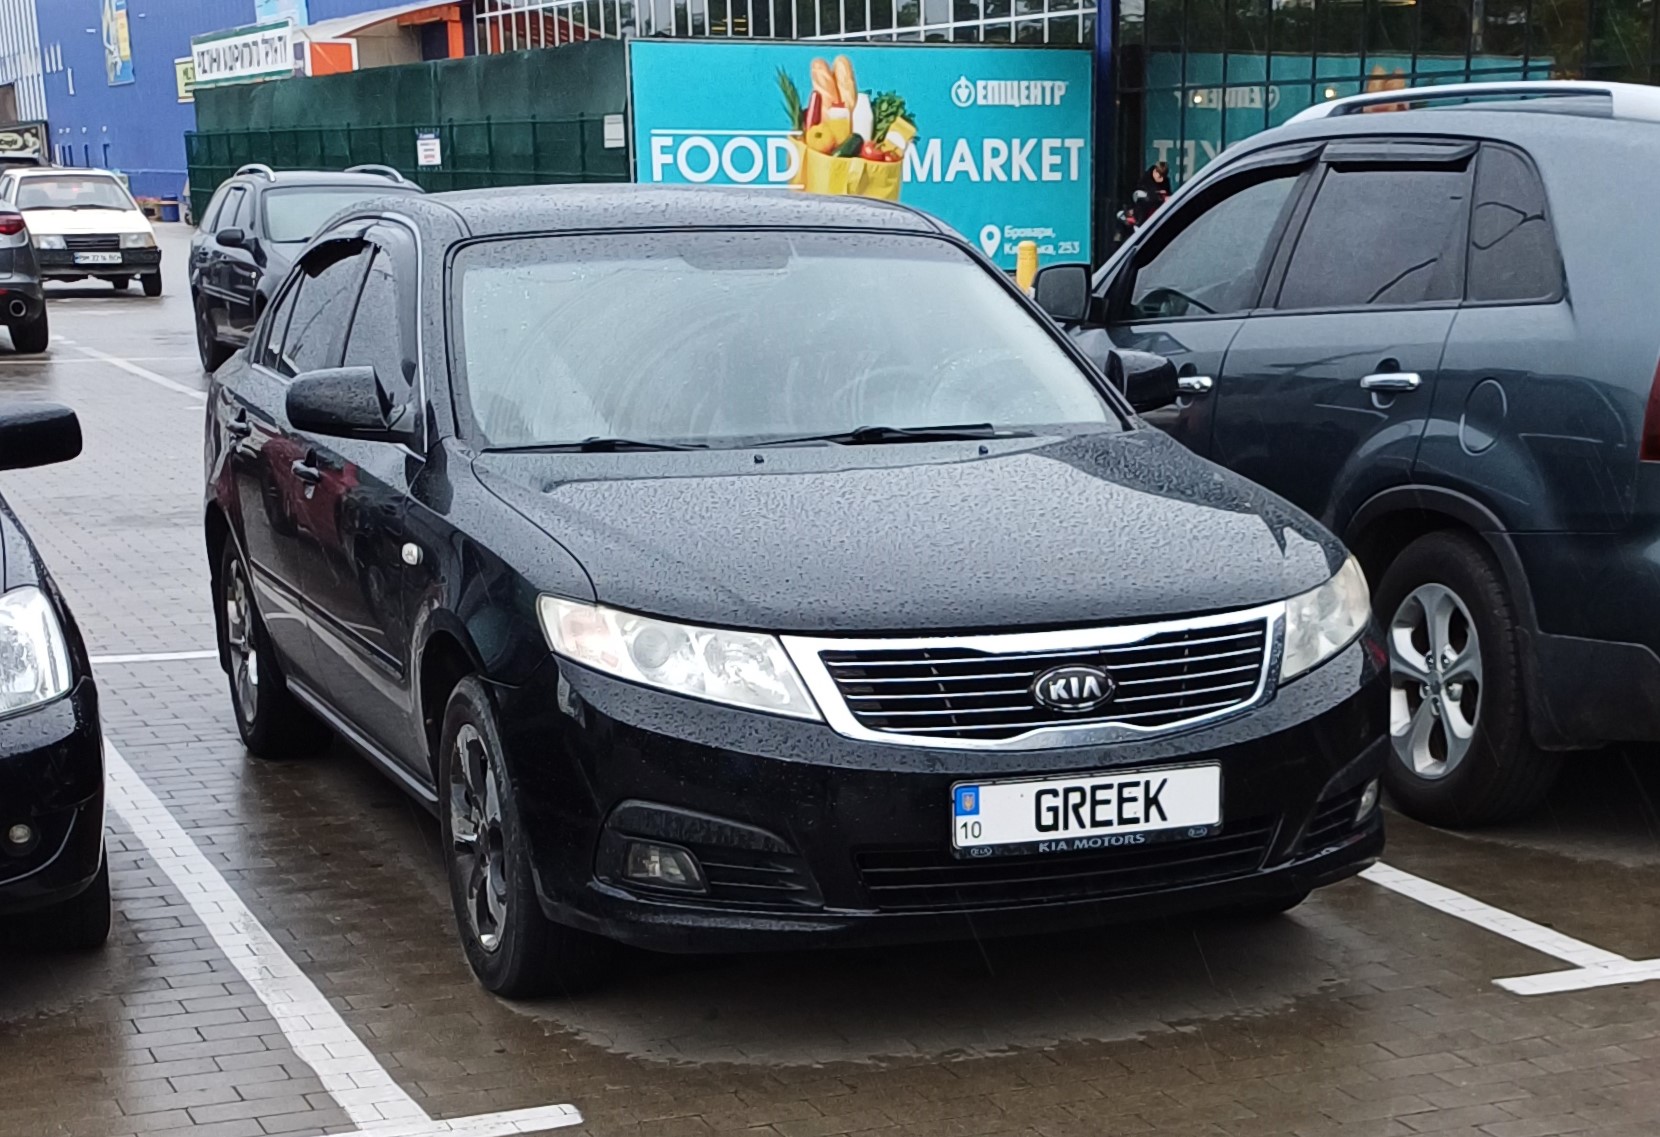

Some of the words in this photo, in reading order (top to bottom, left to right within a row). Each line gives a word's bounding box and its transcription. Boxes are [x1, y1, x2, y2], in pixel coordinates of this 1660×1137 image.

[976, 80, 1067, 107] ЕПІЦЕНТР
[651, 136, 800, 183] FOOD
[902, 138, 1085, 183] MARKET
[1049, 676, 1102, 700] KIA
[1035, 778, 1168, 832] GREEK
[960, 821, 982, 839] 10
[1039, 841, 1068, 853] KIA
[1073, 833, 1146, 849] MOTORS
